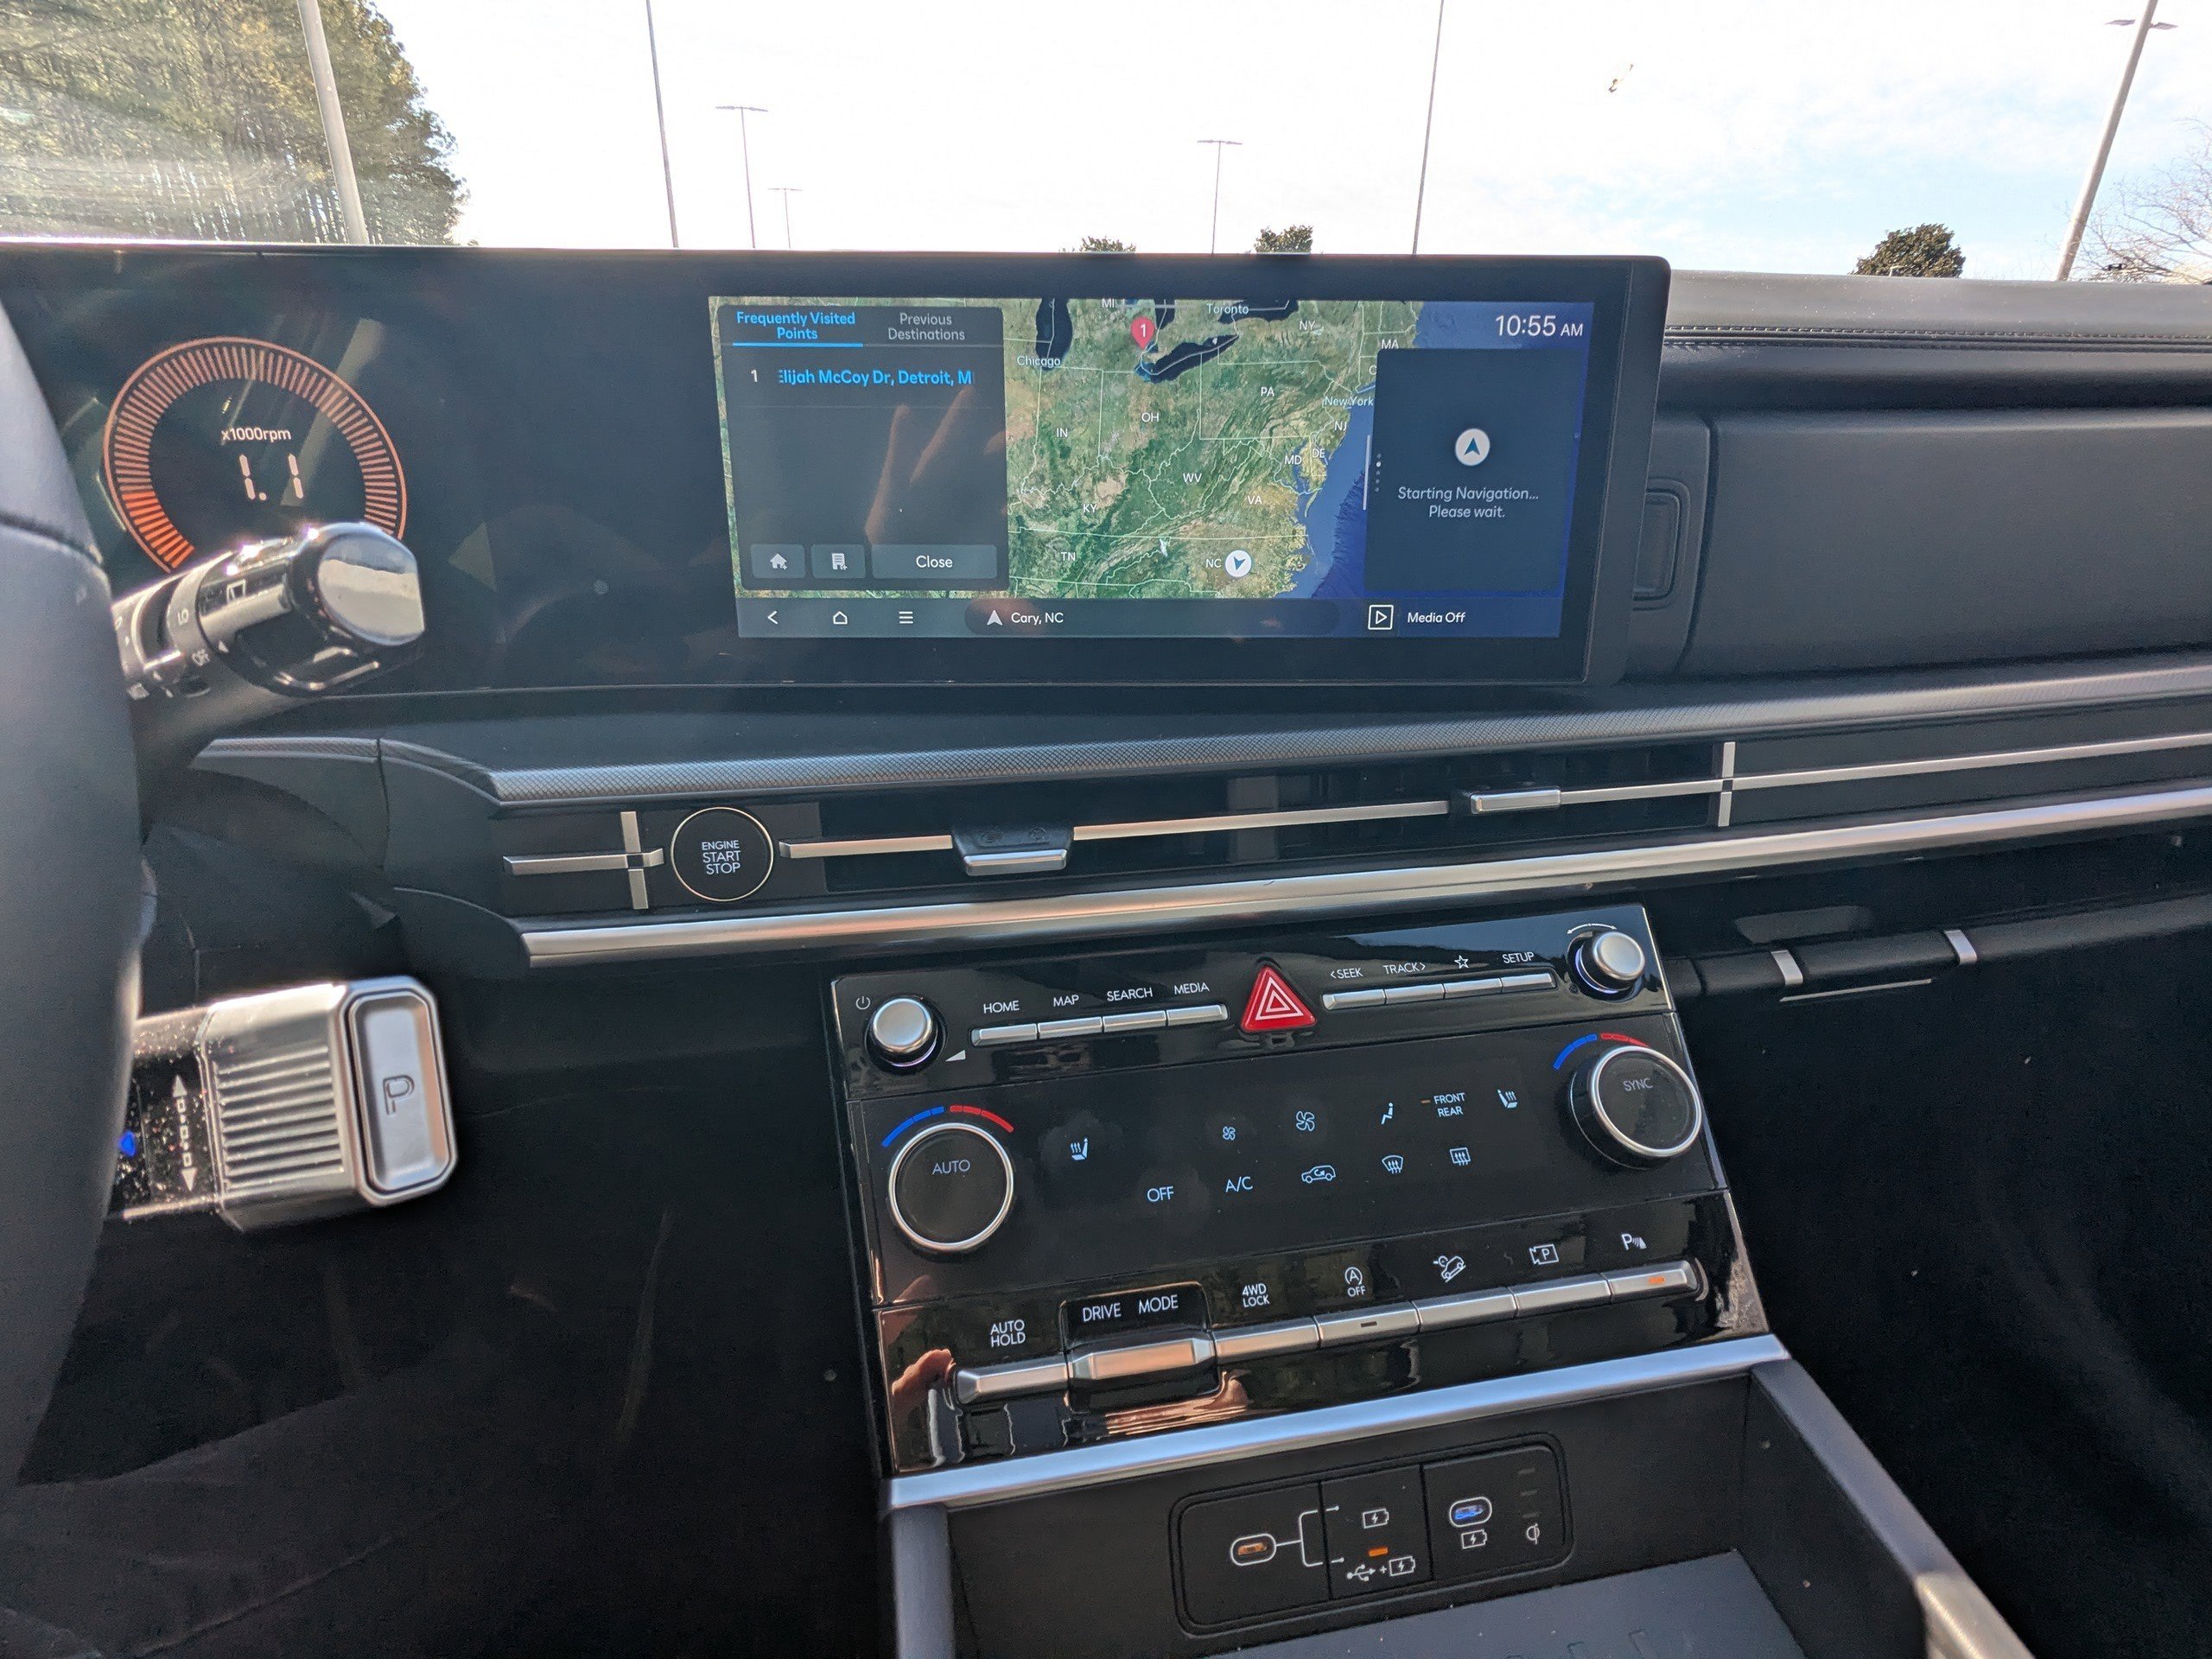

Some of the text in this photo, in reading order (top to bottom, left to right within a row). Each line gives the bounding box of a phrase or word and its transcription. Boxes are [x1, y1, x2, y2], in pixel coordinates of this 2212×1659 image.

[1207, 302, 1249, 315] Toronto
[736, 311, 855, 327] Frequently Visited
[899, 313, 952, 326] Previous
[1140, 324, 1147, 338] 1
[1299, 321, 1316, 331] NY
[1495, 315, 1584, 337] 10:55 AM
[778, 327, 818, 340] Points
[888, 328, 965, 341] Destinations
[1381, 339, 1400, 349] MA
[1016, 356, 1061, 370] Chicago
[751, 370, 759, 383] 1
[819, 369, 870, 387] McCoy
[873, 370, 894, 386] Dr,
[898, 370, 955, 386] Detroit,
[957, 370, 973, 385] M
[1260, 387, 1275, 397] PA
[1325, 396, 1374, 406] New York
[1141, 412, 1160, 423] OH
[1334, 421, 1347, 431] NJ
[221, 428, 291, 442] x1000rpm
[1056, 428, 1068, 438] IN
[1312, 448, 1325, 459] DE
[1284, 455, 1302, 466] MD
[238, 453, 303, 500] 1.1
[1183, 474, 1202, 484] WV
[1247, 495, 1262, 505] VA
[1397, 486, 1539, 503] Starting Navigation...
[1083, 504, 1098, 513] KY
[1428, 505, 1505, 518] Please wait.
[916, 556, 953, 569] Close
[1060, 551, 1077, 562] TN
[1205, 558, 1222, 569] NC
[1011, 612, 1064, 626] Cary, NC
[1407, 612, 1465, 624] Media Off
[702, 840, 740, 851] ENGINE
[702, 850, 741, 864] START
[706, 862, 741, 875] STOP
[1502, 951, 1535, 963] SETUP
[983, 982, 1210, 1014] HOME MAP SEARCH MEDIA
[1623, 1078, 1653, 1092] SYNC
[382, 1074, 415, 1116] P
[1433, 1092, 1465, 1105] FRONT
[1437, 1105, 1464, 1117] REAR
[931, 1159, 971, 1174] AUTO
[1225, 1176, 1253, 1193] A/C
[1147, 1186, 1173, 1202] OFF
[1242, 1283, 1267, 1297] 4WD
[1347, 1285, 1366, 1297] OFF
[1083, 1294, 1178, 1322] DRIVE MODE
[1243, 1295, 1270, 1308] LOCK
[990, 1319, 1025, 1335] AUTO
[990, 1332, 1027, 1348] HOLD
